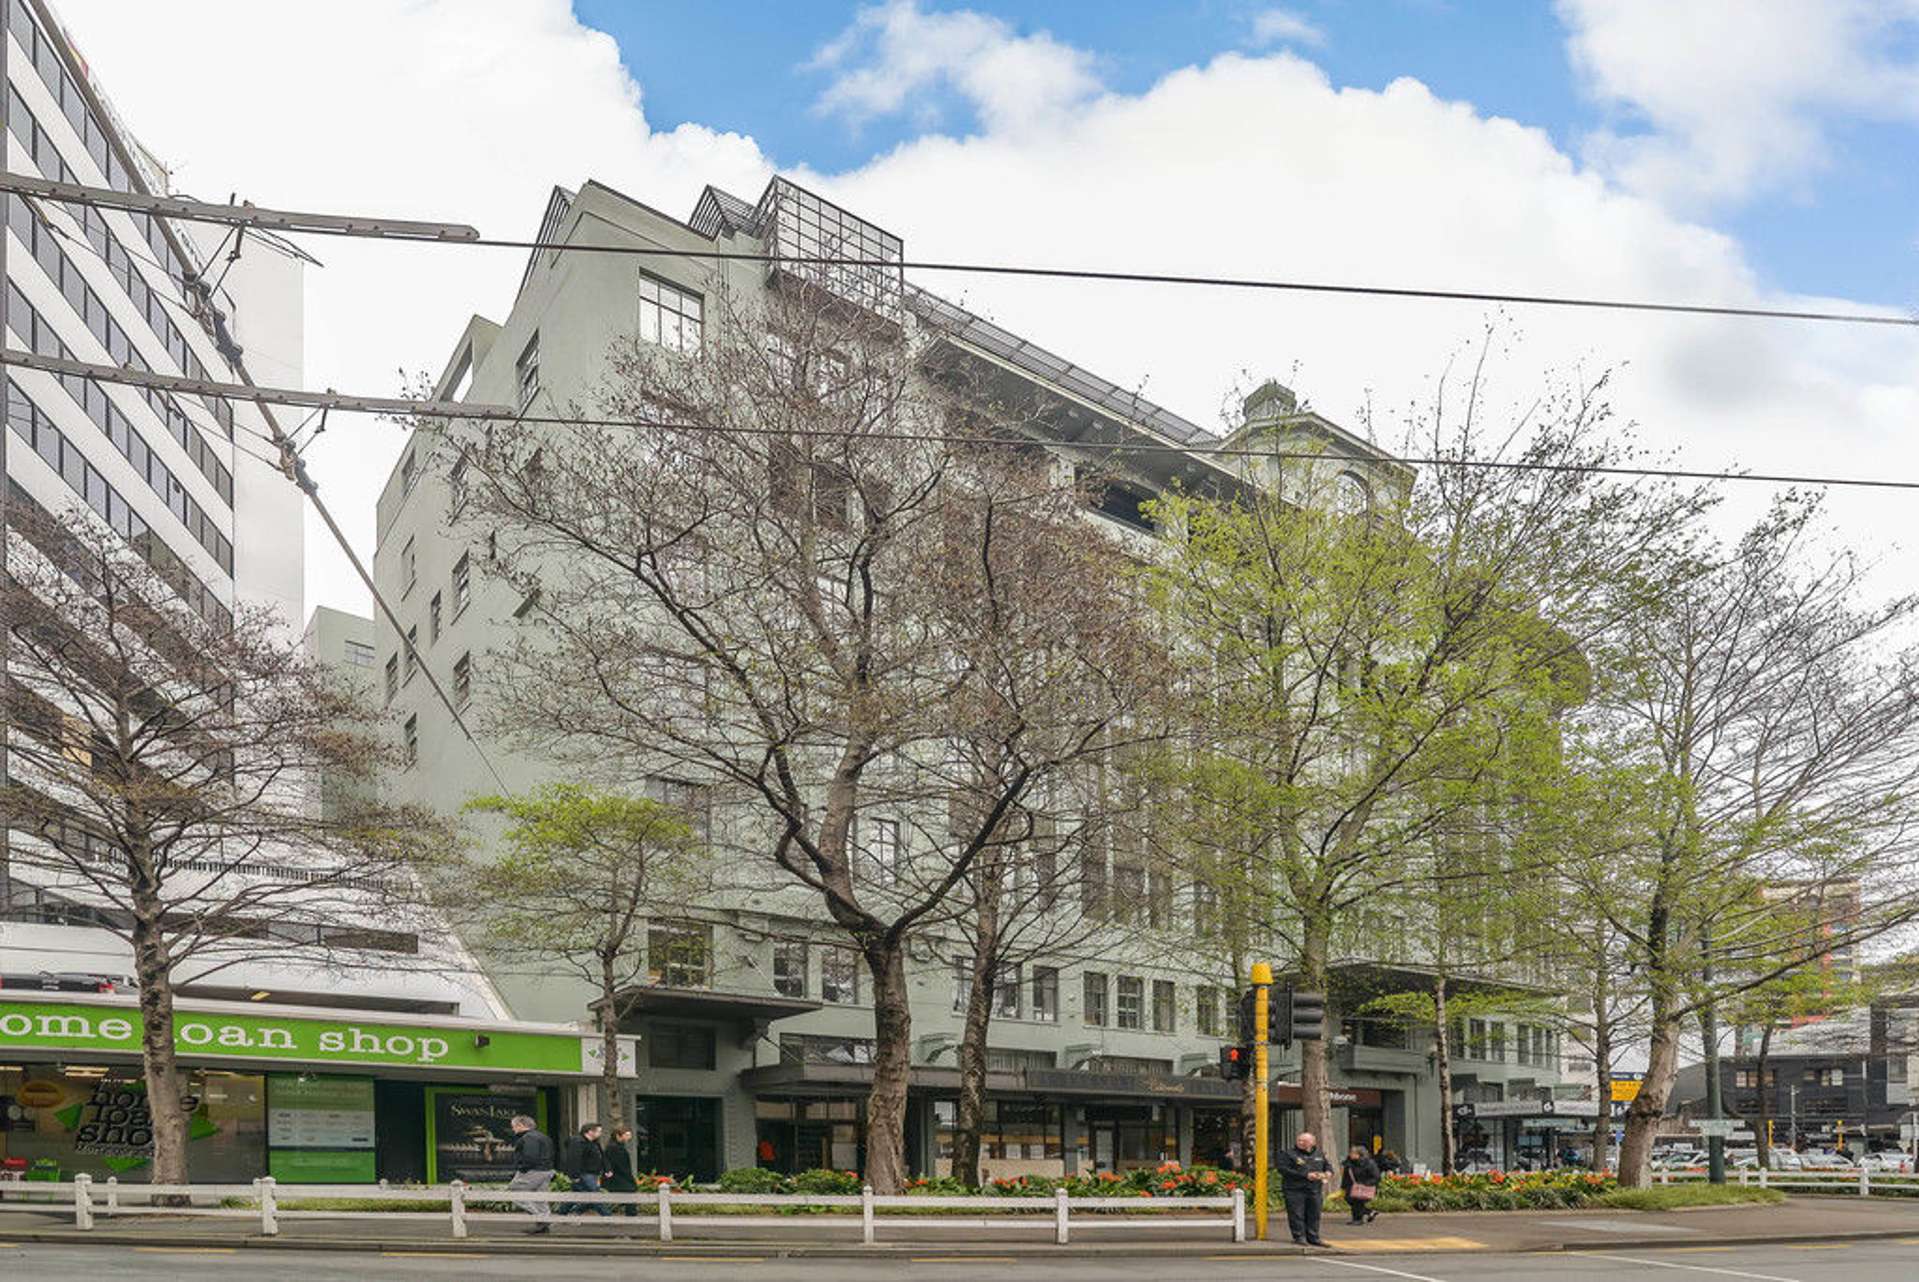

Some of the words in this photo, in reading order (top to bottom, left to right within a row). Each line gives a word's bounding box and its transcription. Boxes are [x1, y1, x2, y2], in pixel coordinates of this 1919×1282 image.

[0, 1013, 132, 1040] ome
[174, 1022, 298, 1049] oan
[319, 1028, 449, 1062] shop
[90, 1104, 154, 1126] loa
[76, 1122, 154, 1147] sho
